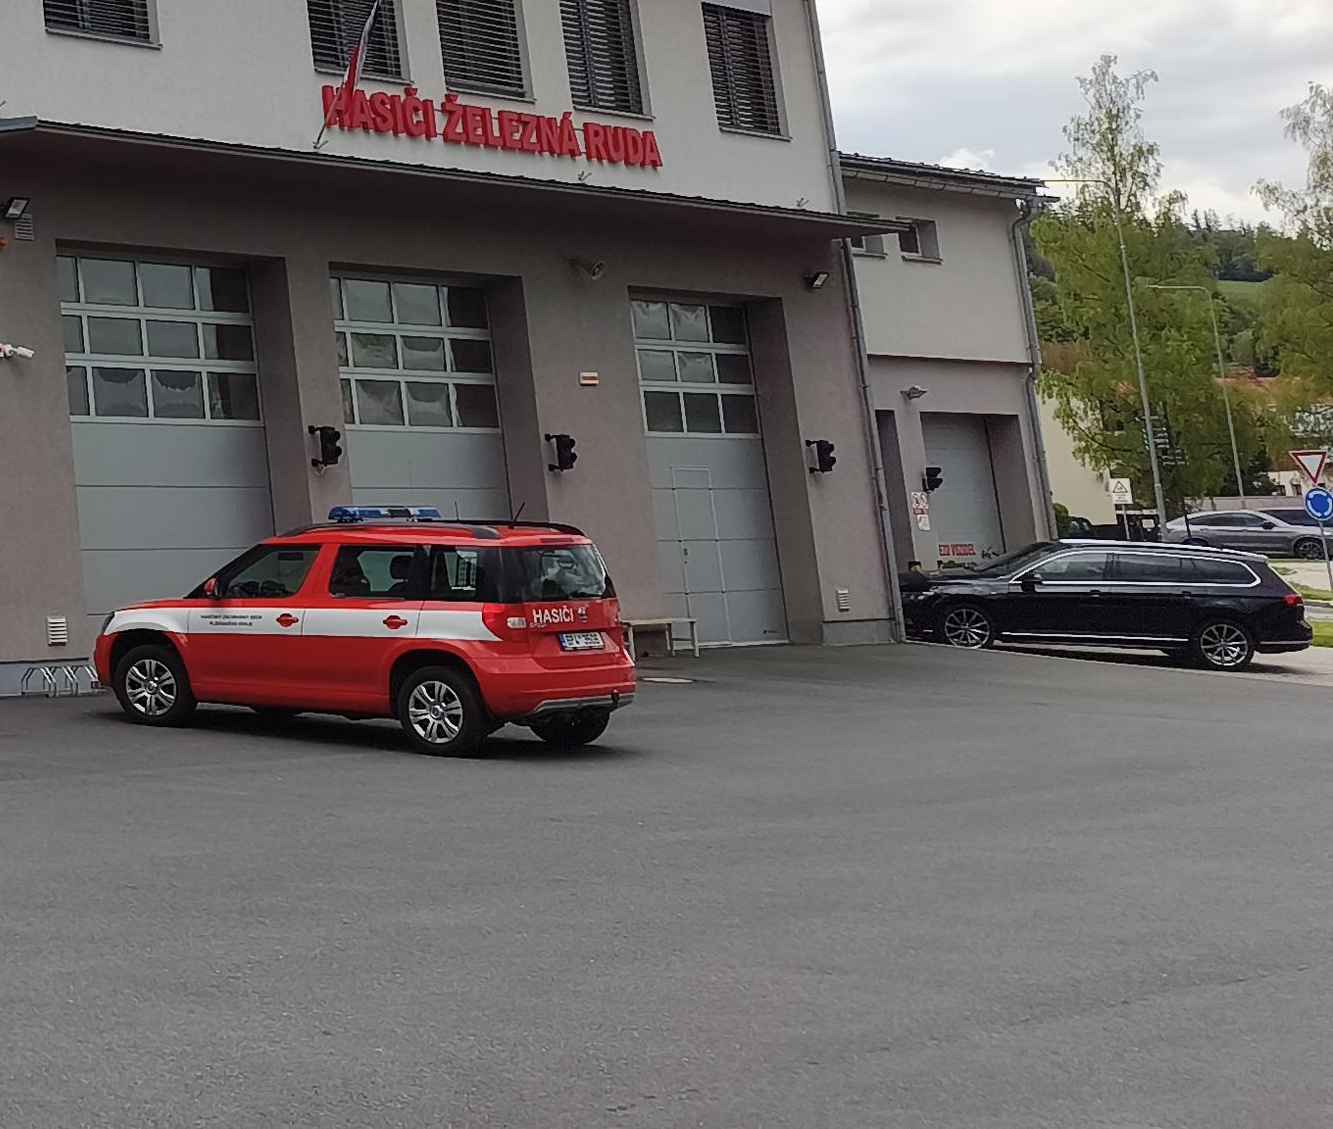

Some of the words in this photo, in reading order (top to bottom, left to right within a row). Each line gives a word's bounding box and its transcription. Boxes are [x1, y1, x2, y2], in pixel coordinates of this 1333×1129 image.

[322, 85, 437, 139] HASIČI
[441, 94, 581, 157] ŽELEZNÁ
[583, 122, 662, 167] RUDA
[532, 605, 574, 623] HASIČI
